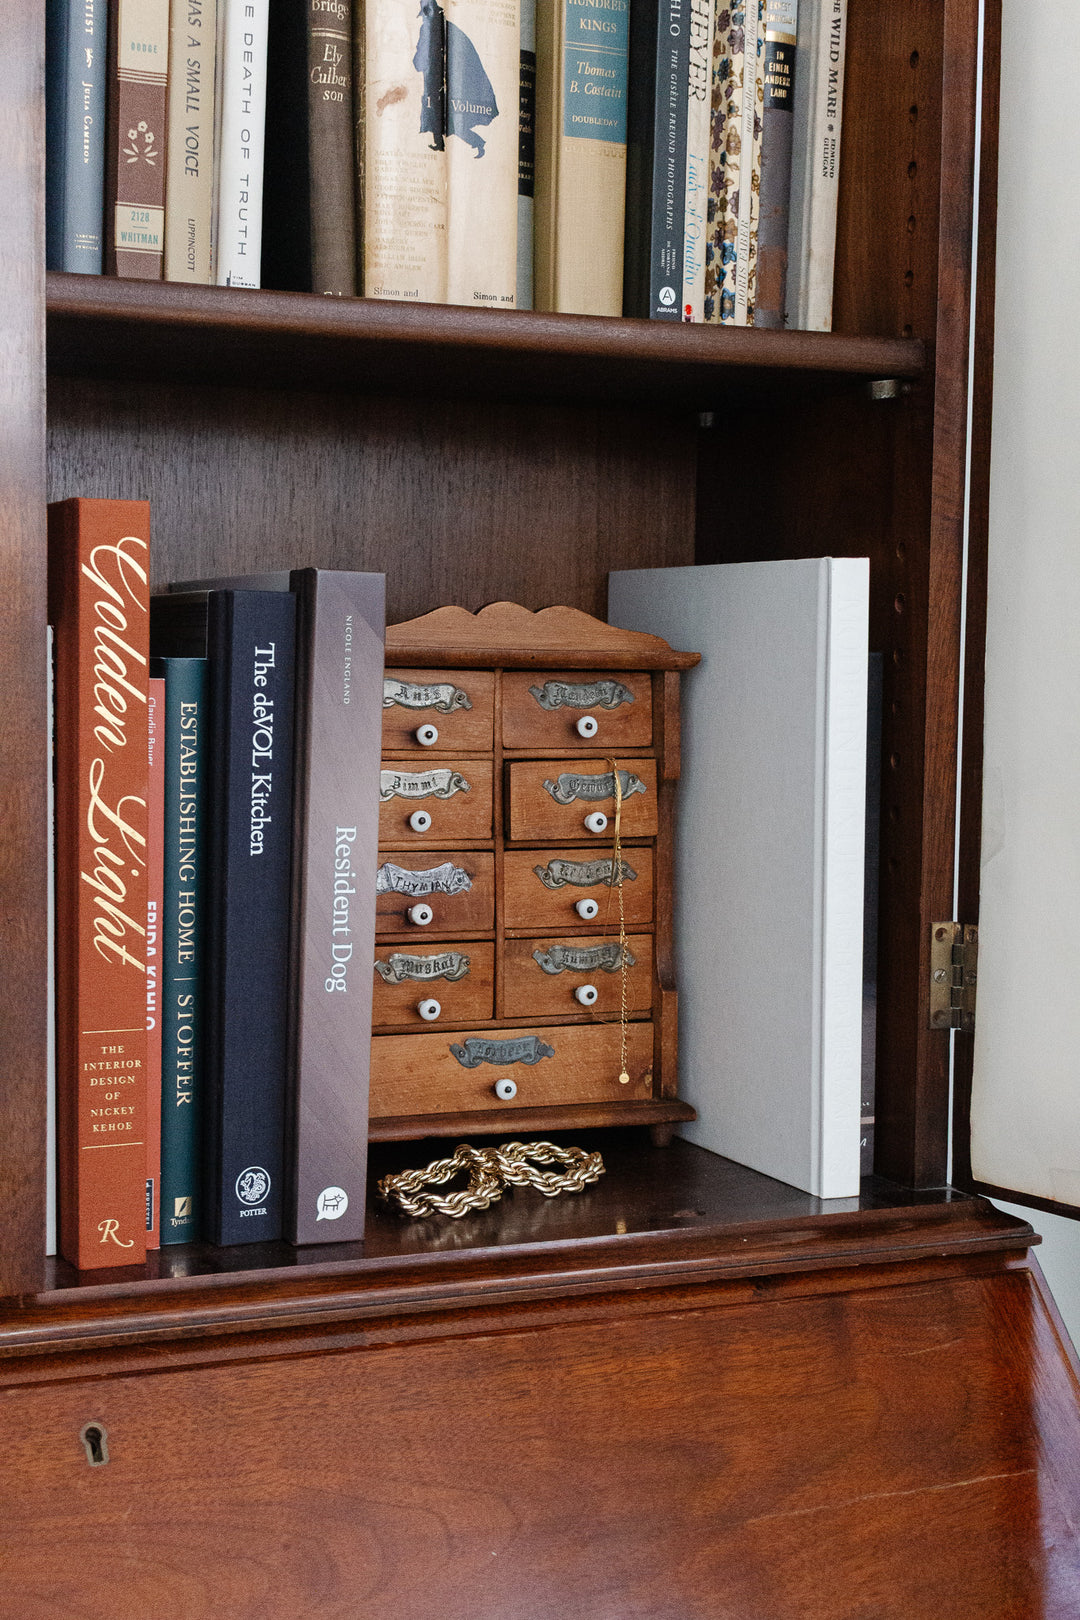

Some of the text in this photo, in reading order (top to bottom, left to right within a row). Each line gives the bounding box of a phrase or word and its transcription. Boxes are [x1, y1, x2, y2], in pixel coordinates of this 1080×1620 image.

[580, 18, 617, 34] KINGS
[131, 41, 158, 54] DODGE
[187, 35, 201, 48] A
[830, 18, 842, 63] WILD
[323, 44, 343, 66] Ely
[776, 51, 784, 61] IN
[242, 33, 254, 114] DEATH
[577, 61, 616, 78] Thomas
[185, 57, 201, 113] SMALL
[570, 80, 622, 98] B. Costain
[669, 73, 679, 109] GISÈLE
[770, 89, 787, 98] LAND
[827, 69, 840, 119] MARE
[323, 90, 344, 102] son
[451, 100, 493, 115] Volume
[571, 114, 619, 128] DOUBLEDAY
[83, 115, 93, 164] CAMERON
[668, 112, 677, 154] FREUND
[184, 125, 200, 177] VOICE
[240, 129, 250, 160] OF
[822, 137, 830, 178] GILLIGAN
[665, 157, 675, 231] PHOTOGRAPHS
[131, 210, 150, 223] 2128
[237, 174, 249, 256] TRUTH
[120, 231, 158, 245] WHITMAN
[186, 218, 196, 273] LIPPINCOTT
[738, 219, 749, 307] DORIS FABER
[373, 286, 419, 298] Simon and
[473, 291, 514, 304] Simon and
[656, 306, 678, 314] ABRAMS
[343, 615, 353, 705] NICOLE ENGLAND
[81, 536, 148, 973] Golden Light
[250, 642, 276, 856] The deVOL Kitchen
[395, 876, 451, 895] THYMIAN
[176, 701, 197, 1107] ESTABLISHING HOME STOFFER
[325, 826, 357, 993] Resident Dog
[101, 1045, 125, 1055] THE
[84, 1059, 142, 1071] INTERIOR
[90, 1075, 136, 1087] DESIGN
[105, 1092, 121, 1101] OF
[90, 1106, 136, 1117] NICKEY
[92, 1122, 133, 1133] KEHOE
[240, 1207, 267, 1218] POTTER
[97, 1218, 135, 1248] R
